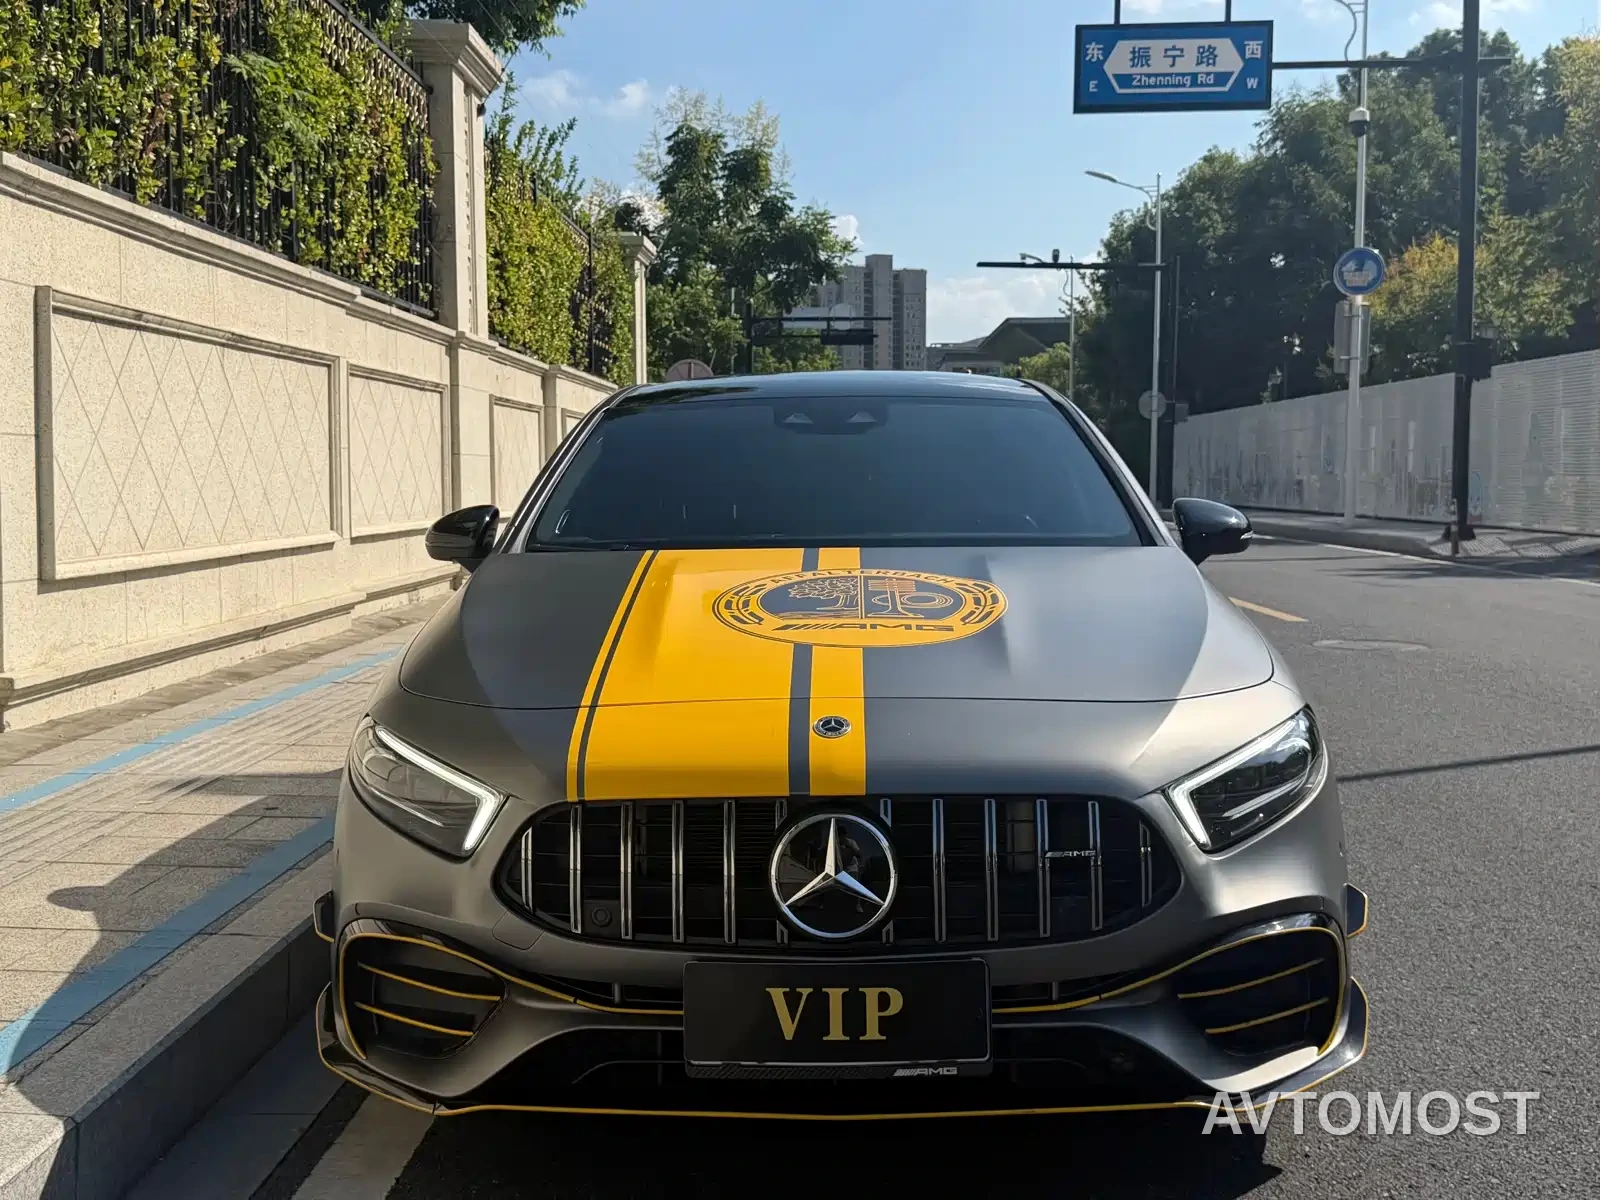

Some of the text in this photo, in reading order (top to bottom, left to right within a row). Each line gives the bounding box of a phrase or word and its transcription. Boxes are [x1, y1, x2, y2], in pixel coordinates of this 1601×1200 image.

[1085, 42, 1104, 62] 东
[1129, 44, 1218, 68] 振宁路
[1244, 40, 1263, 59] 西
[1088, 80, 1098, 92] E
[1131, 73, 1215, 87] Zhenning Rd
[1246, 77, 1259, 89] W
[765, 987, 904, 1041] VIP
